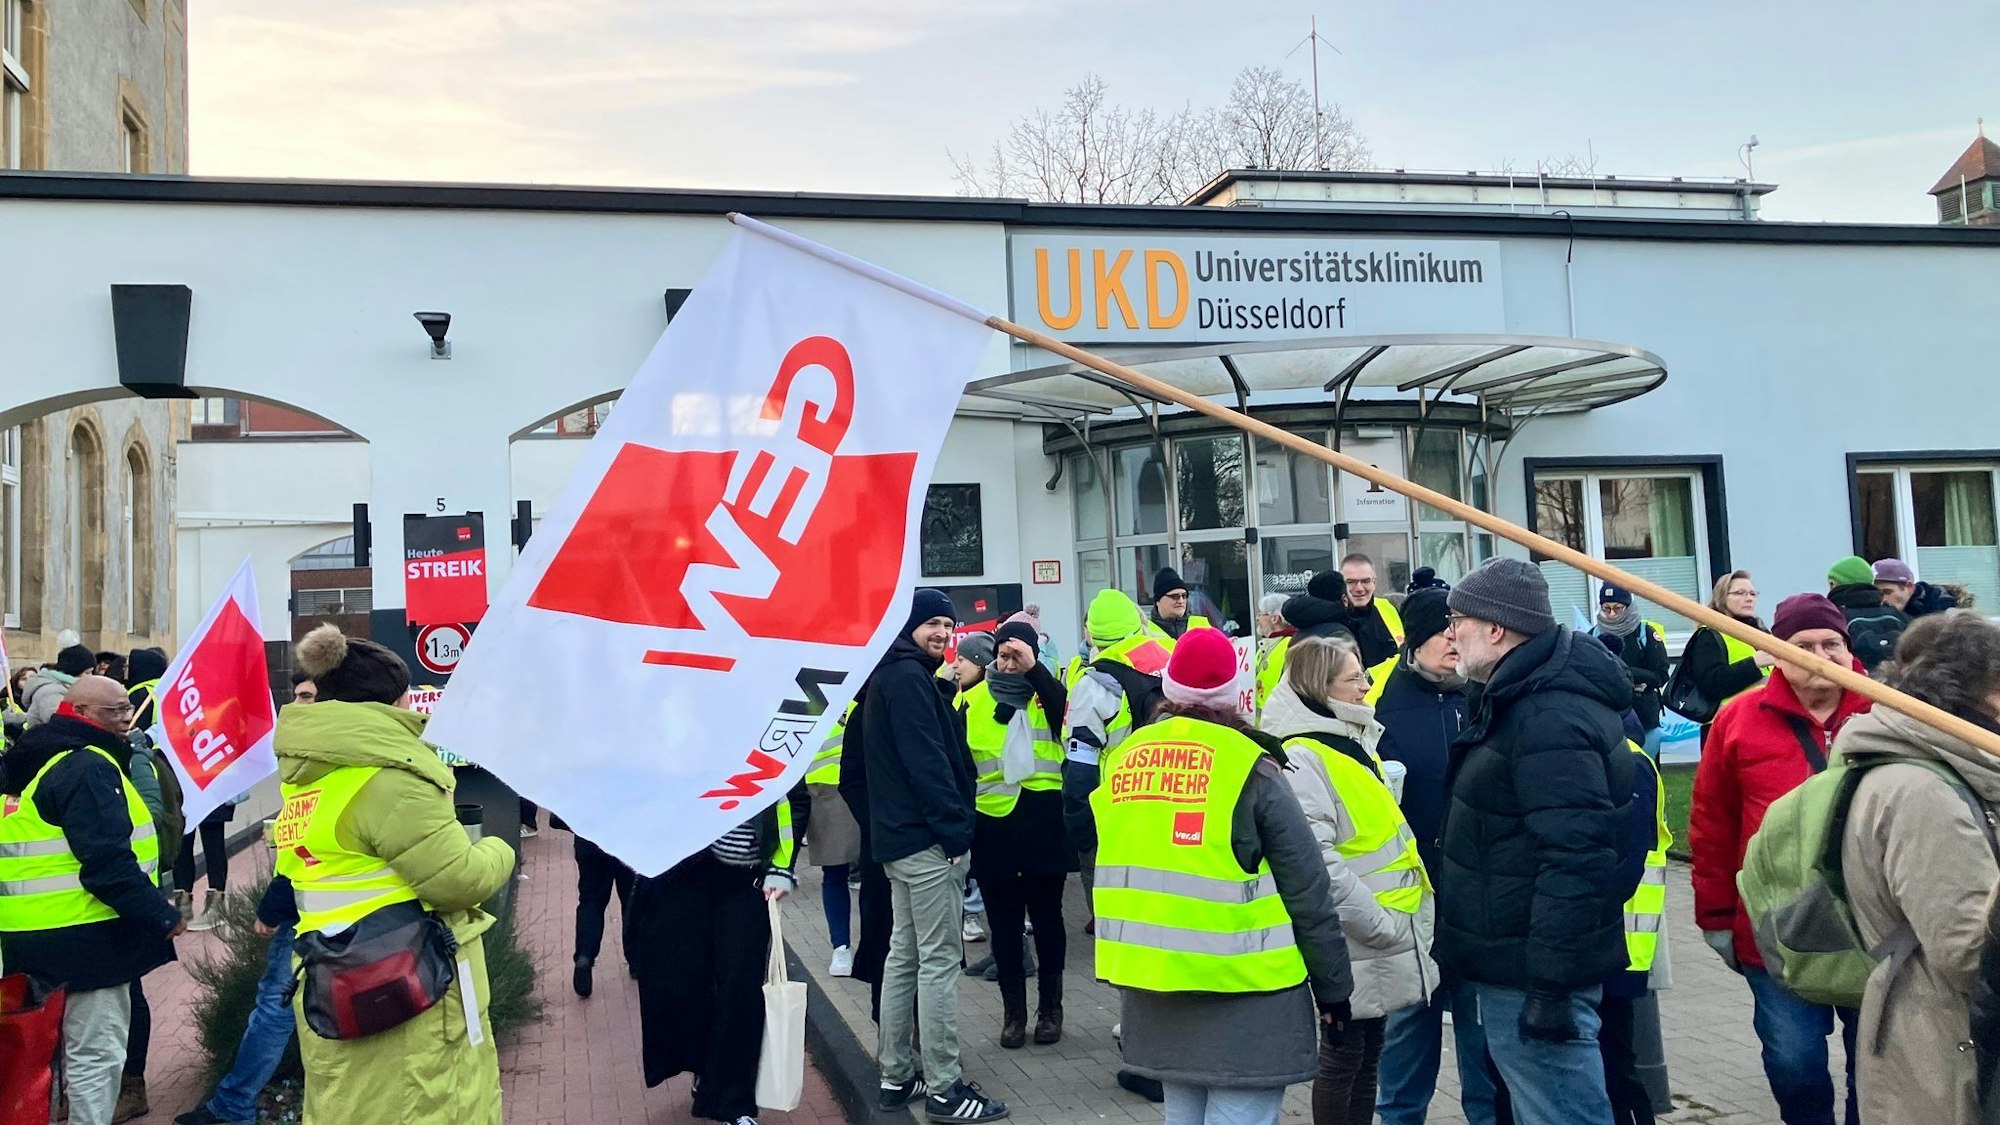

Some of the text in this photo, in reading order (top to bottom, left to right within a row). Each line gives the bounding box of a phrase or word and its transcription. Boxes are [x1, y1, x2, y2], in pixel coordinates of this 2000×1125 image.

[1195, 250, 1483, 284] Universitätsklinikum
[1035, 247, 1189, 331] UKD
[1198, 297, 1346, 330] Düsseldorf
[436, 497, 446, 511] 5
[1356, 498, 1396, 507] Information
[407, 548, 444, 559] Heute
[407, 559, 482, 580] STREIK
[1111, 771, 1210, 795] GEHT MEHR
